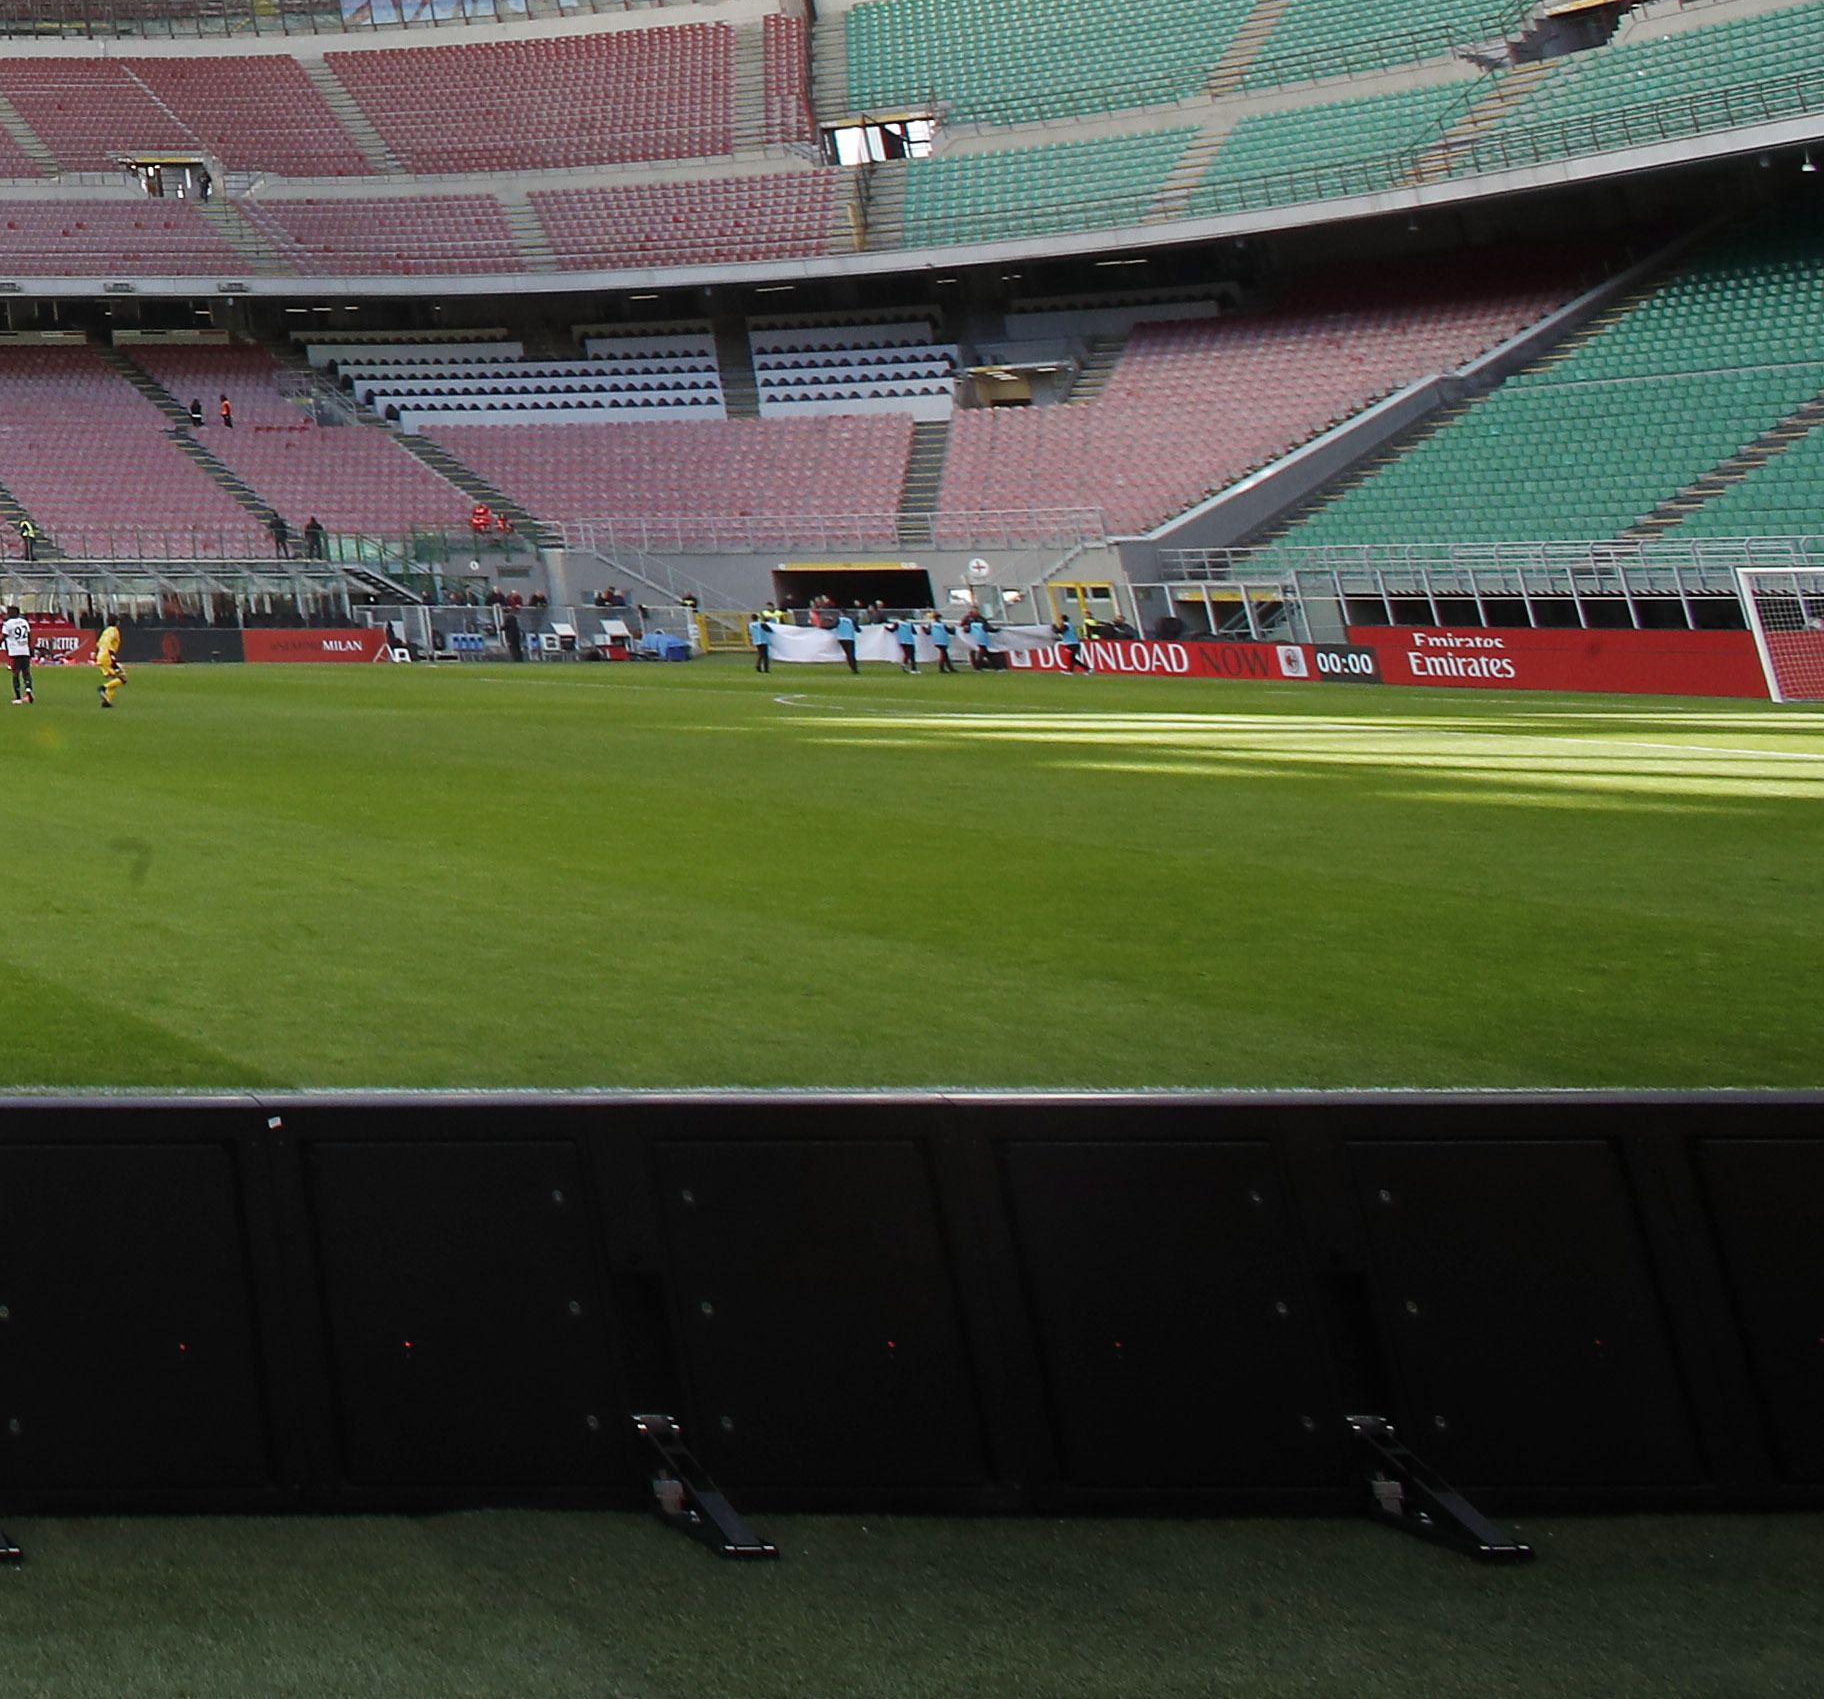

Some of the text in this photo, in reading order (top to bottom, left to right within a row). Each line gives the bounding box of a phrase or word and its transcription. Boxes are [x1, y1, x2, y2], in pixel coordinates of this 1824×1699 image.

[14, 625, 28, 640] 92
[1199, 646, 1270, 677] NOW
[1316, 651, 1374, 675] 00:00
[1407, 652, 1516, 679] Emirates
